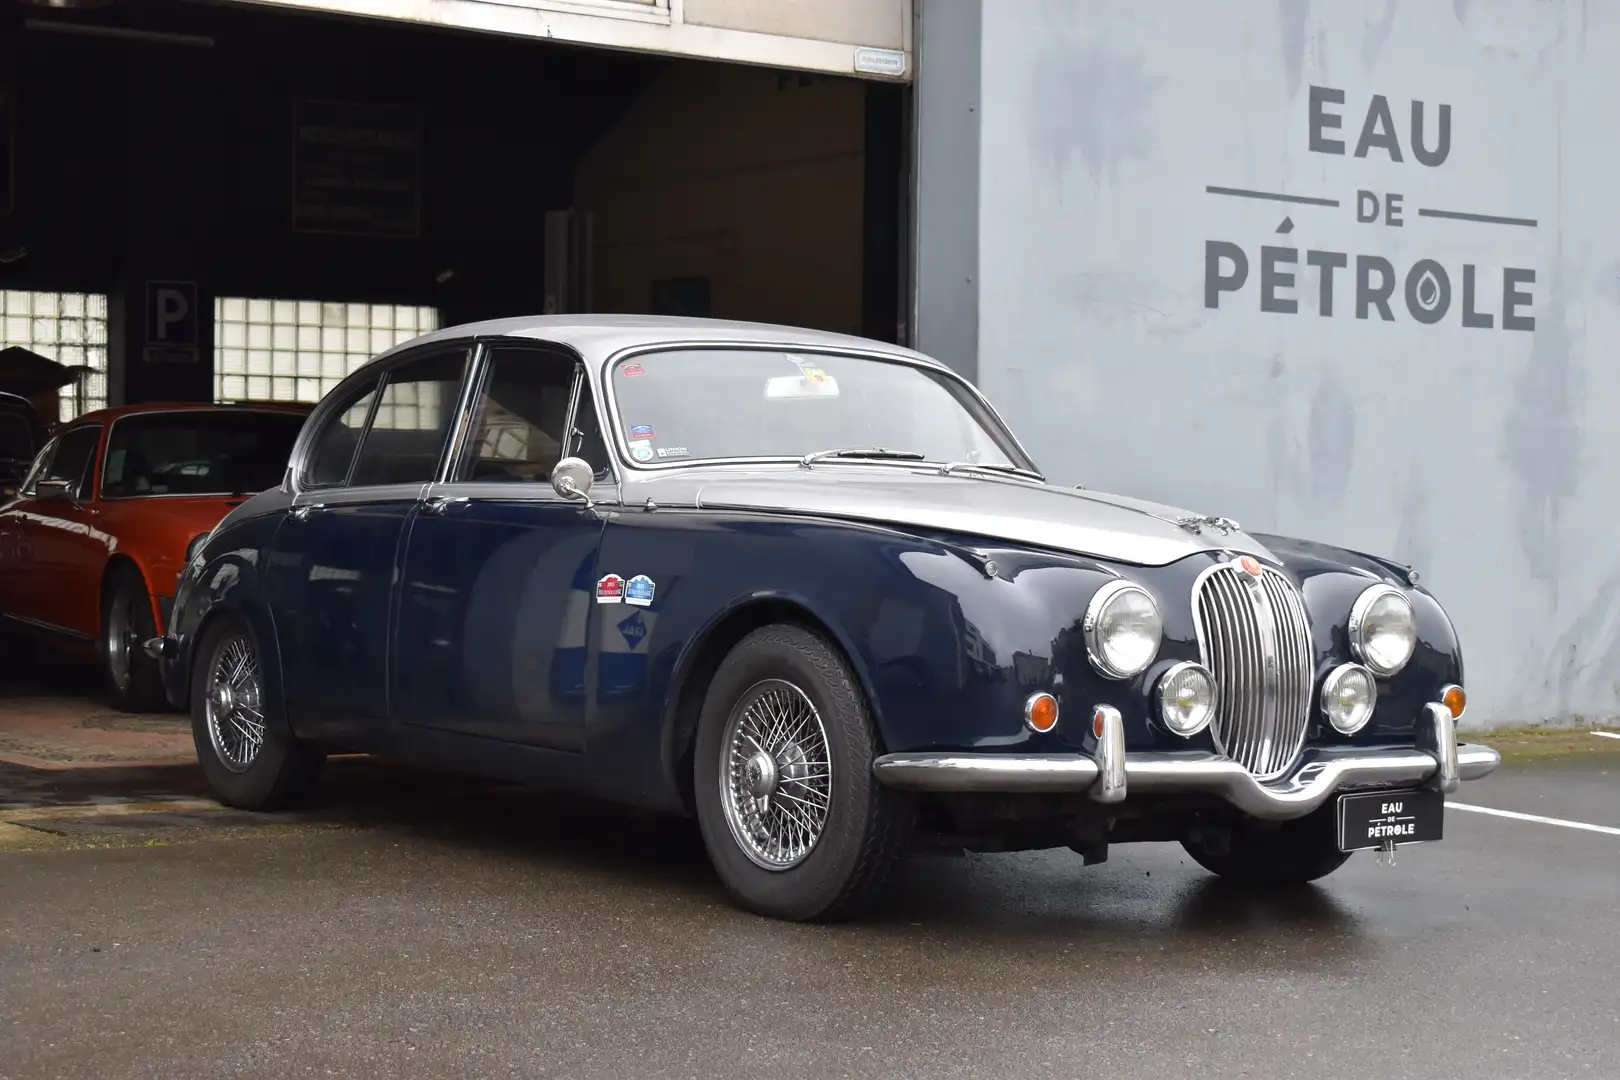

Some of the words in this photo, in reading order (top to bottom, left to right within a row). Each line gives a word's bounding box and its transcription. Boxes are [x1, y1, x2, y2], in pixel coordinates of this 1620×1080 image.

[1308, 85, 1452, 168] EAU
[1357, 189, 1404, 227] DE
[1204, 216, 1536, 332] PÉTROLE
[157, 288, 188, 340] P
[1367, 823, 1415, 838] PÉTROLE
[1381, 802, 1403, 814] EAU
